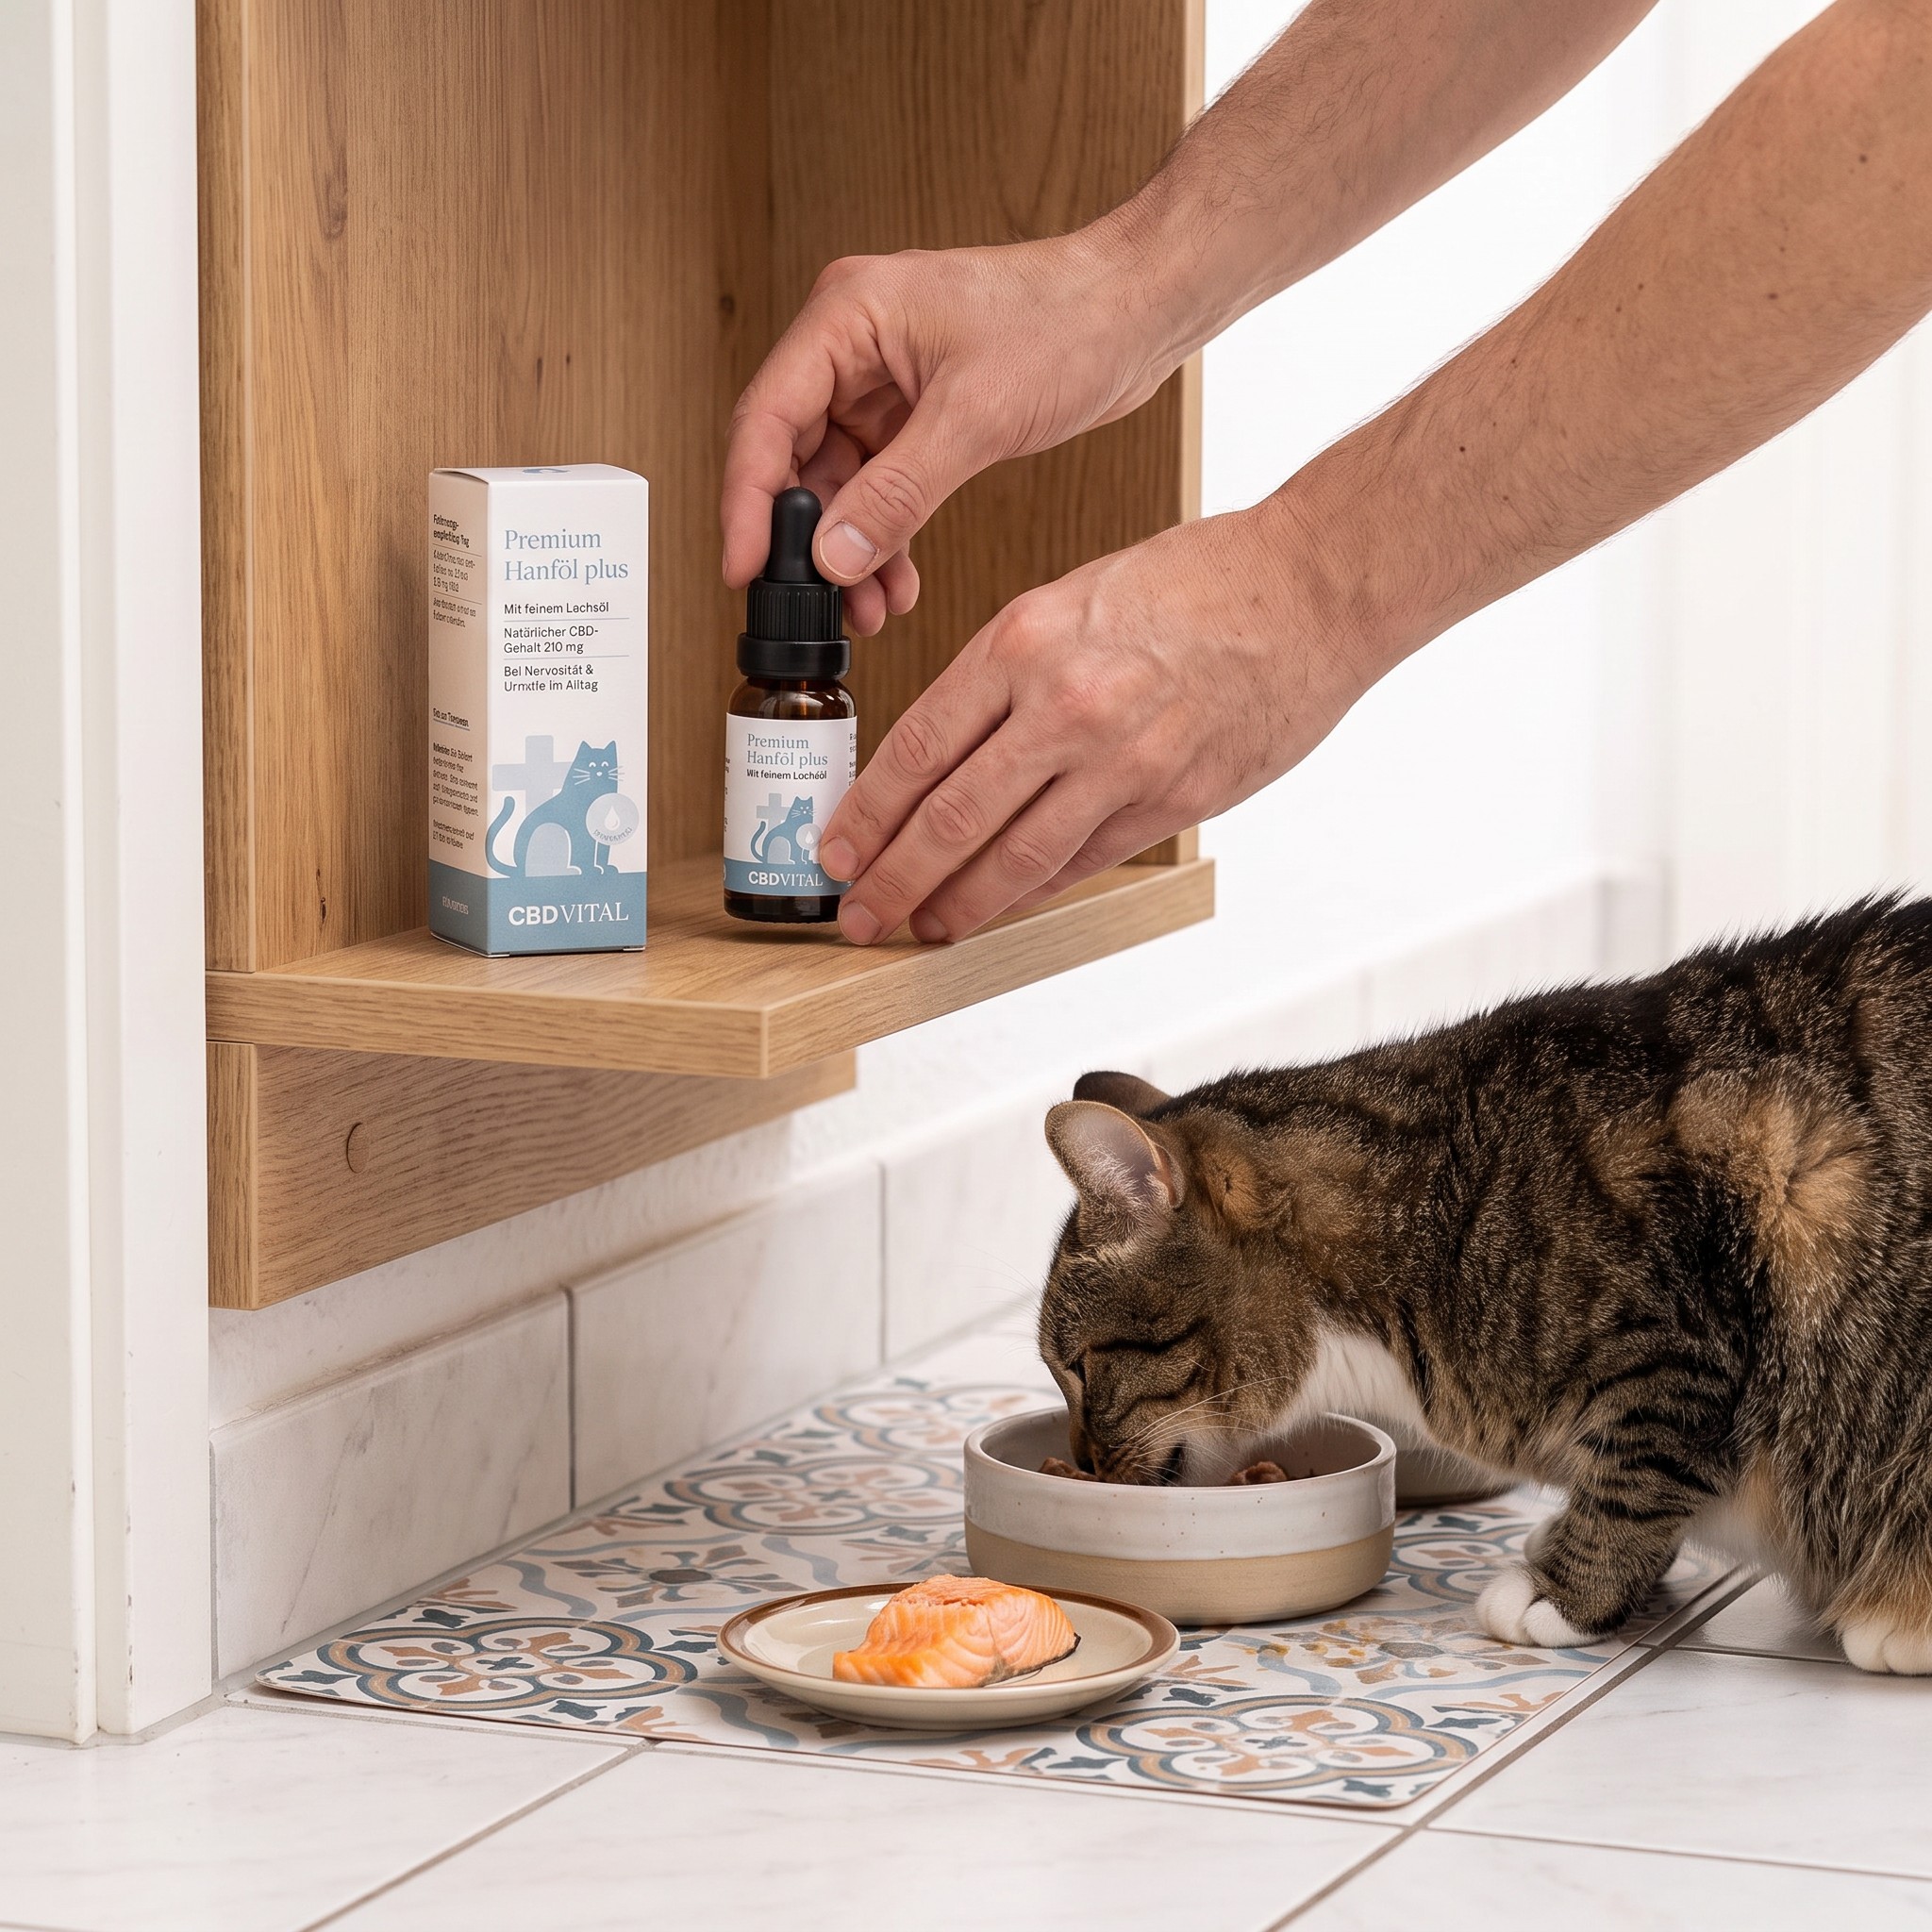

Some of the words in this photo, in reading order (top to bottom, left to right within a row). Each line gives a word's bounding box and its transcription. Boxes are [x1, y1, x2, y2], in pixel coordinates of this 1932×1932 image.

[505, 528, 602, 549] Premium
[505, 558, 578, 581] Hanföl
[584, 558, 629, 585] plus
[504, 604, 522, 614] Mit
[525, 603, 563, 614] feinem
[566, 602, 609, 613] Lachsöl
[569, 625, 599, 637] CBD-
[504, 641, 541, 653] Gehalt
[543, 641, 563, 652] 210
[566, 642, 584, 655] mg
[585, 663, 594, 675] &
[747, 733, 809, 749] Premium
[799, 752, 828, 769] plus
[760, 769, 792, 780] feinem
